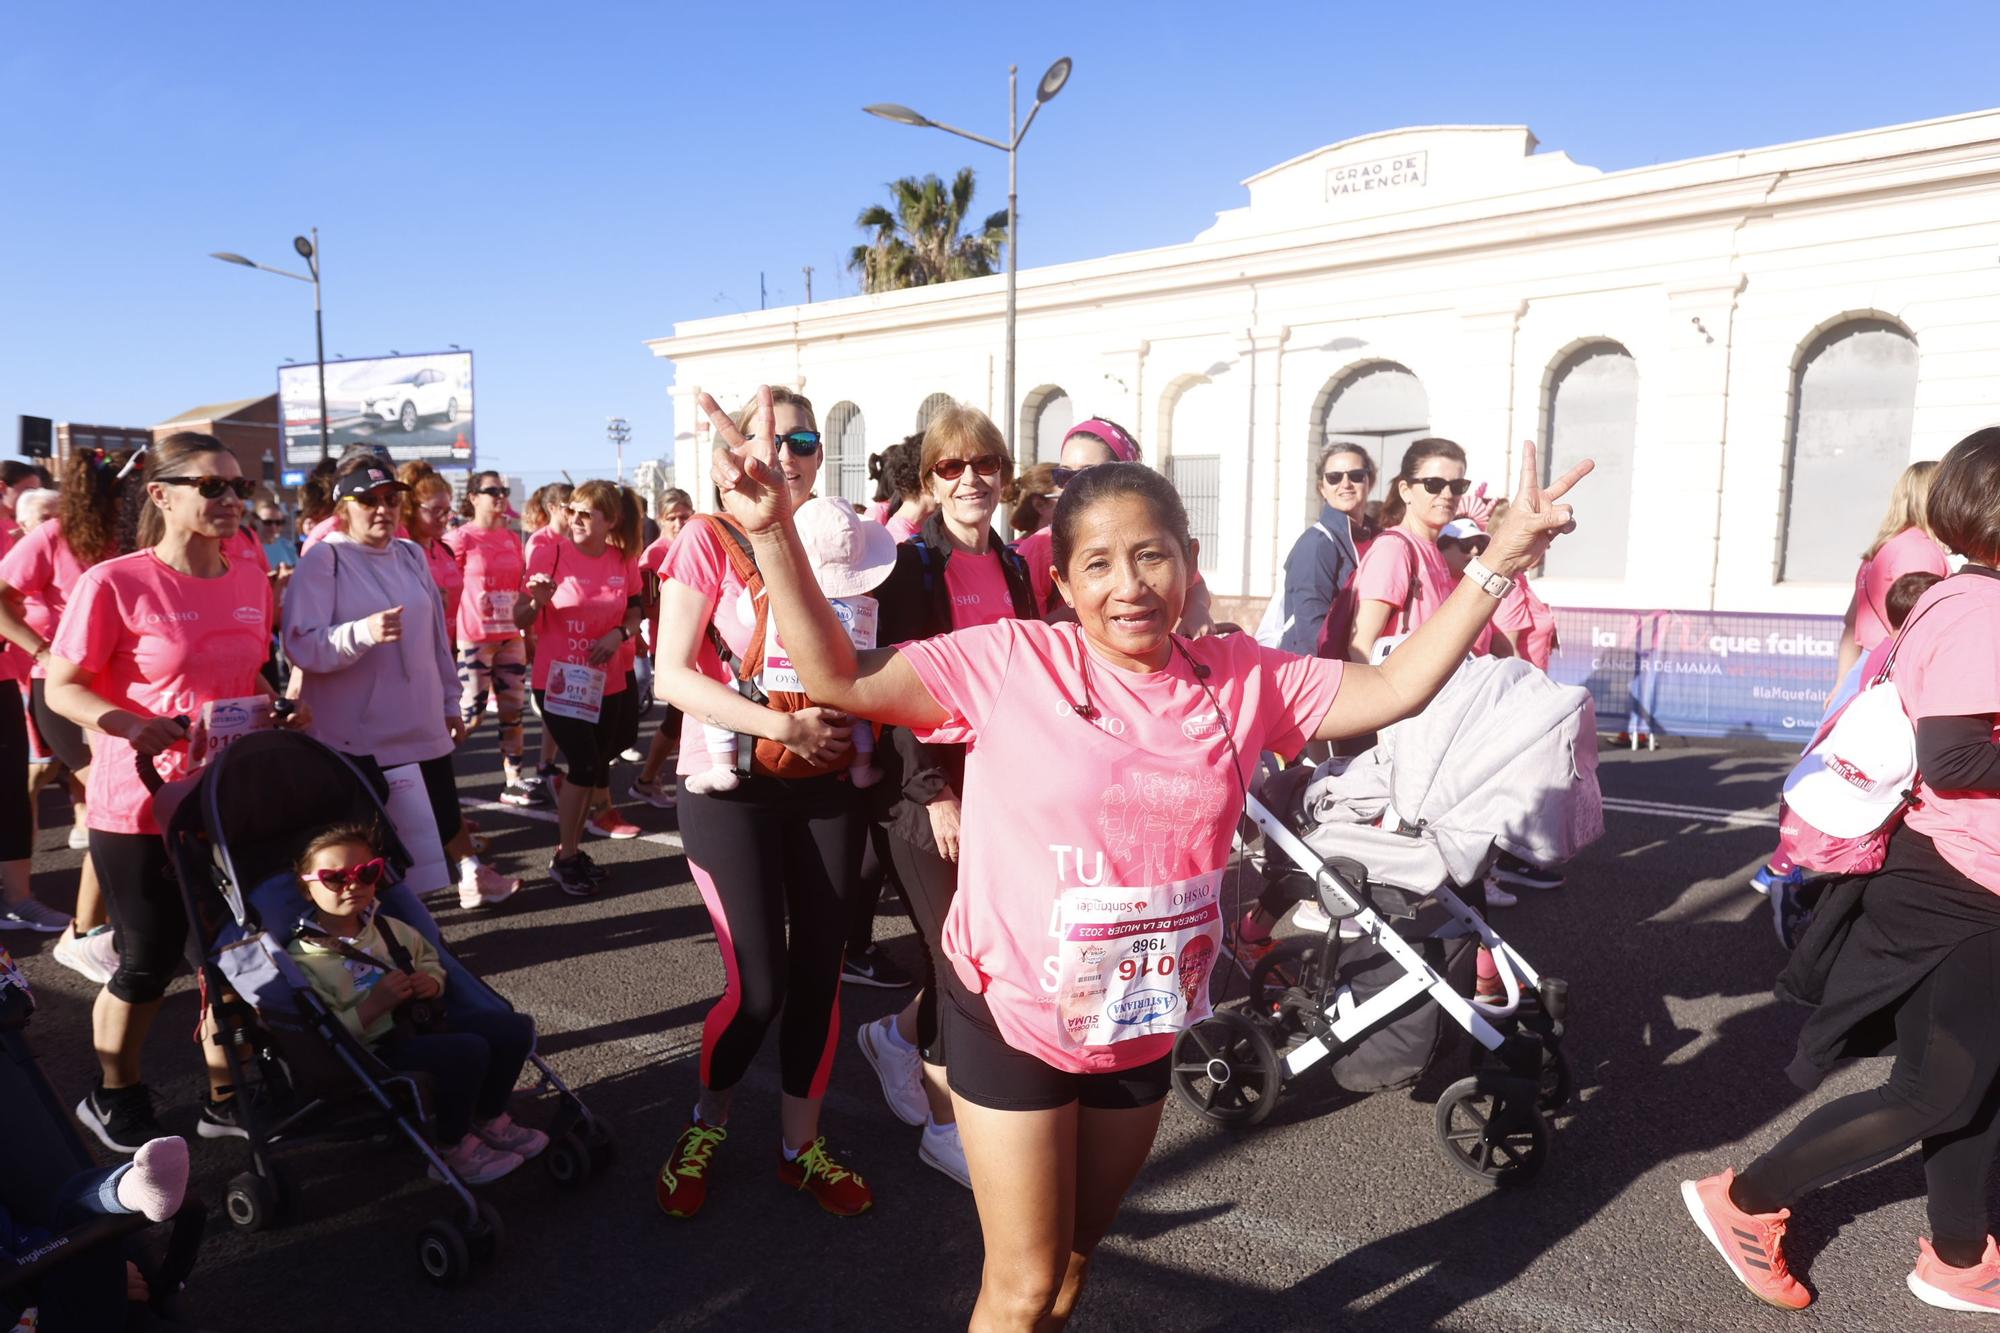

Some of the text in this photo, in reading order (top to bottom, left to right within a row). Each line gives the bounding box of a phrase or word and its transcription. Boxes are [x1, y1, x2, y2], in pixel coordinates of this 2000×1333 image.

[1335, 157, 1417, 181] GRAO DE
[1331, 172, 1420, 195] VALENCIA
[1592, 627, 1617, 648] la
[1709, 635, 1764, 657] que
[1766, 633, 1834, 656] falta
[1654, 660, 1673, 673] DE
[1676, 661, 1723, 675] MAMA
[160, 690, 195, 713] TU
[1753, 686, 1827, 702] #laMquefalt
[1049, 844, 1104, 886] TU
[1077, 901, 1133, 913] Santander
[1173, 885, 1210, 906] OYSHO
[1079, 911, 1209, 937] CARRERA DE LA MUJER 2023
[1132, 938, 1167, 952] 1968
[1118, 955, 1175, 981] 016
[1113, 996, 1173, 1014] ASTURIANA
[1068, 1014, 1099, 1027] SUMA
[16, 1237, 69, 1265] Inglesina
